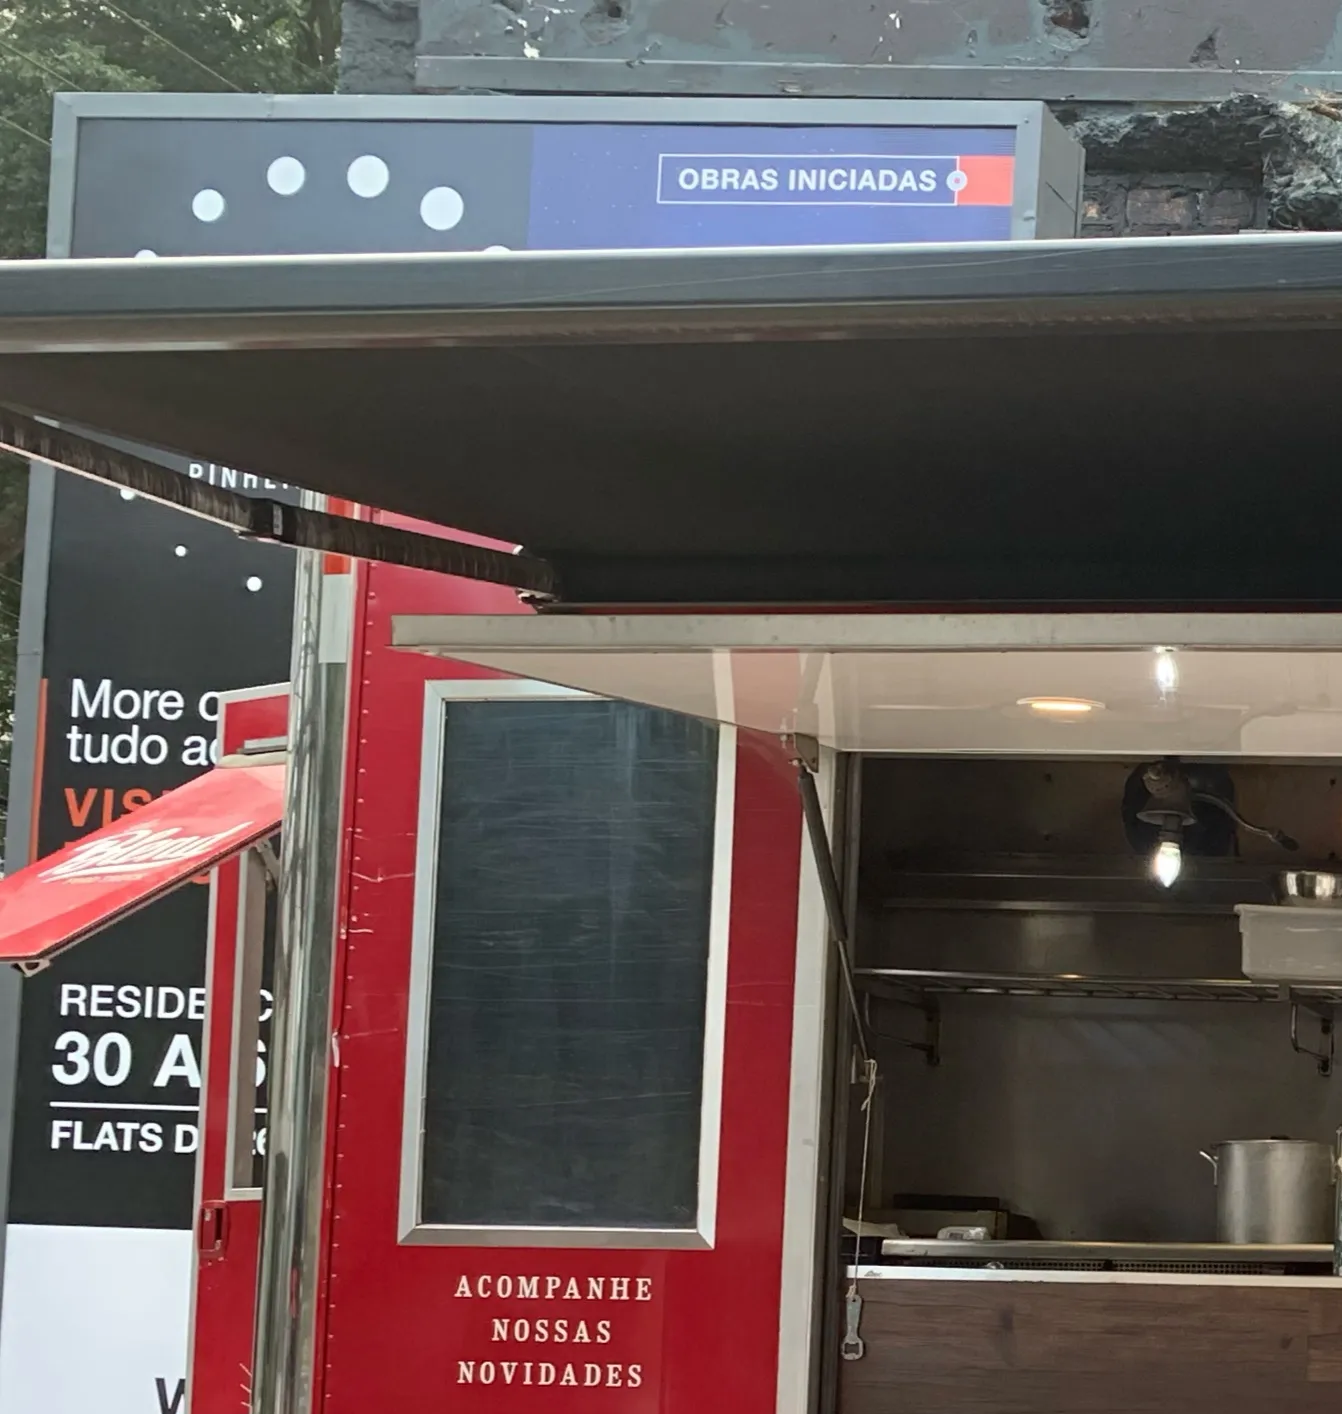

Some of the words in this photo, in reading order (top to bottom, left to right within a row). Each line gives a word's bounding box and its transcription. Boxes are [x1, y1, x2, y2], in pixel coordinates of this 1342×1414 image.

[678, 168, 778, 191] OBRAS
[788, 168, 937, 193] INICIADAS
[70, 678, 184, 721] More
[66, 724, 168, 767] tudo
[52, 1030, 132, 1087] 30
[51, 1120, 163, 1152] FLATS
[454, 1275, 653, 1301] ACOMPANHE
[491, 1318, 612, 1343] NOSSAS
[456, 1361, 643, 1387] NOVIDADES
